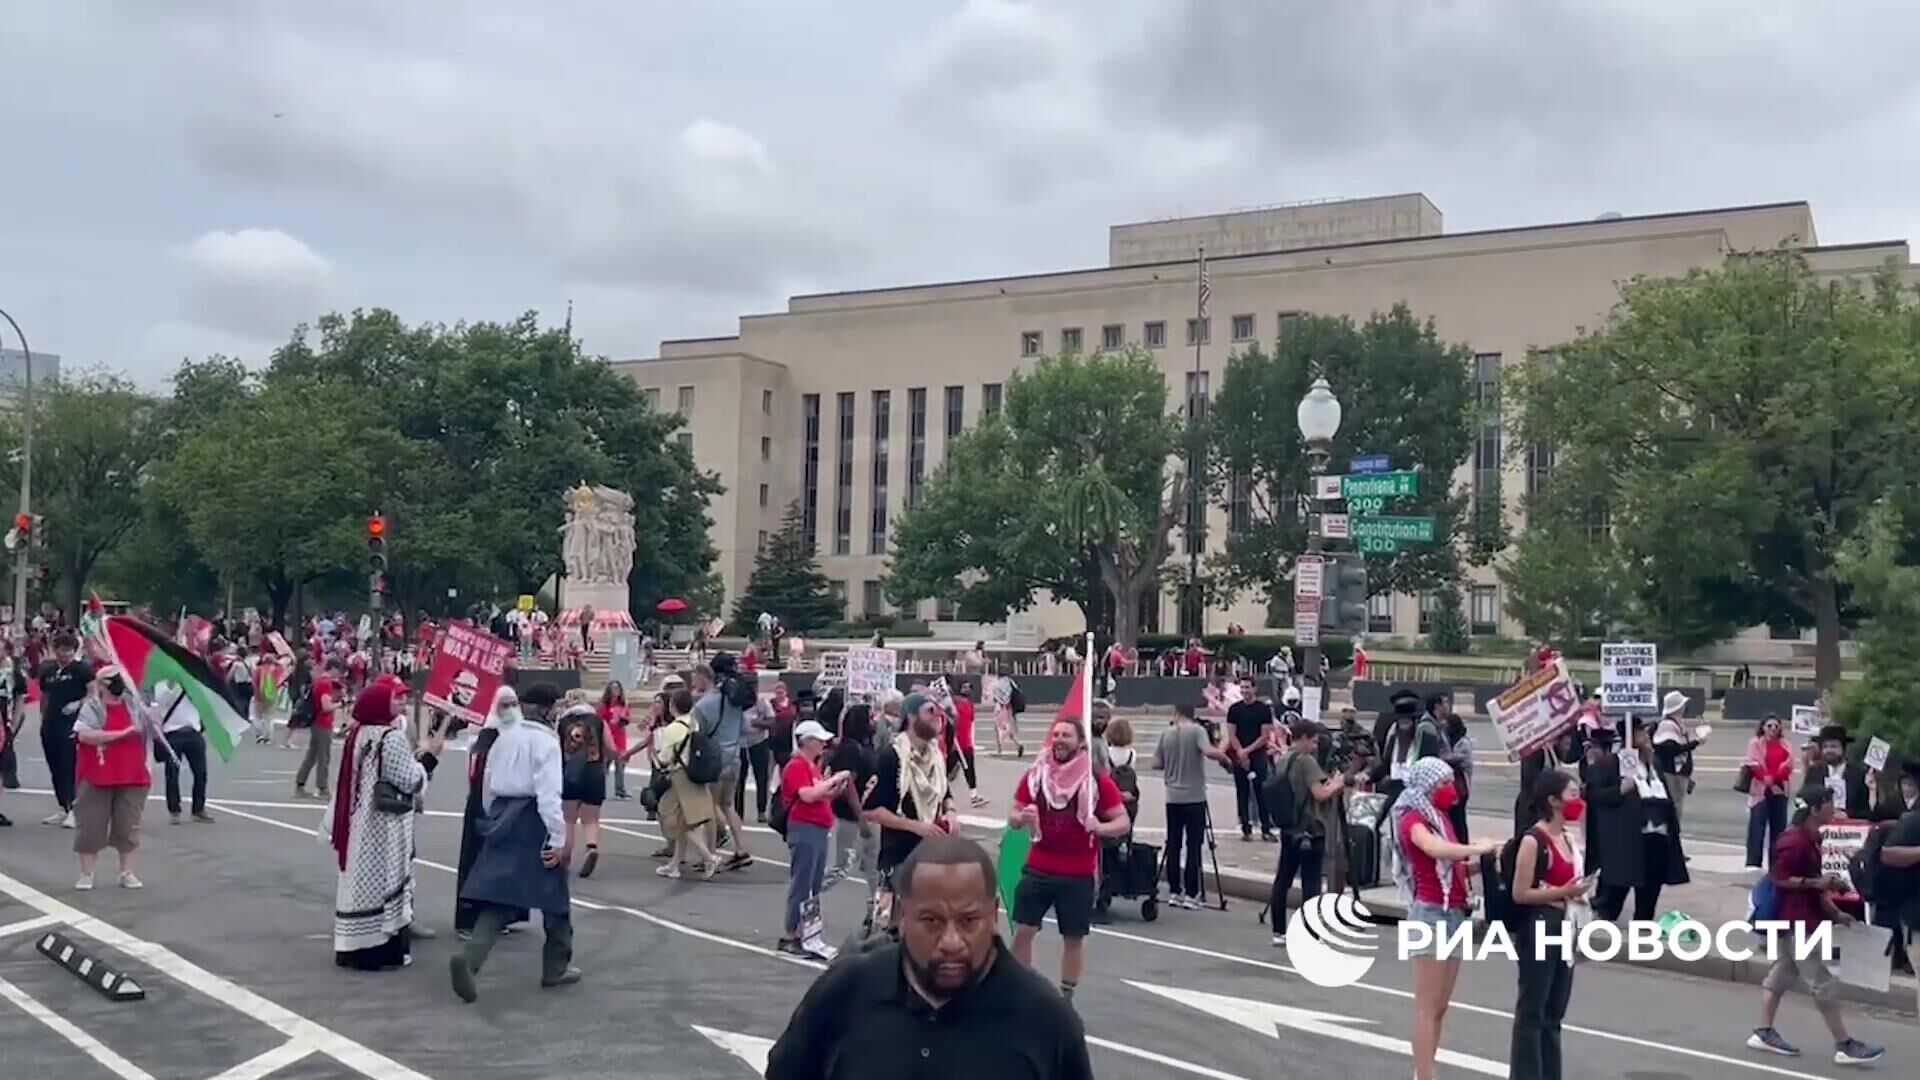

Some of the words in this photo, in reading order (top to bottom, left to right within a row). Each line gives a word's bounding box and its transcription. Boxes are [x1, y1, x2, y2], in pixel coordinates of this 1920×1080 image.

[1344, 477, 1395, 498] Pennsylvania
[1353, 498, 1382, 511] 300
[1350, 519, 1417, 538] Constitution
[1363, 539, 1395, 551] 300
[443, 636, 470, 662] WAS
[468, 648, 480, 665] A
[1616, 667, 1642, 676] WHEN
[1604, 683, 1634, 692] PEOPLE
